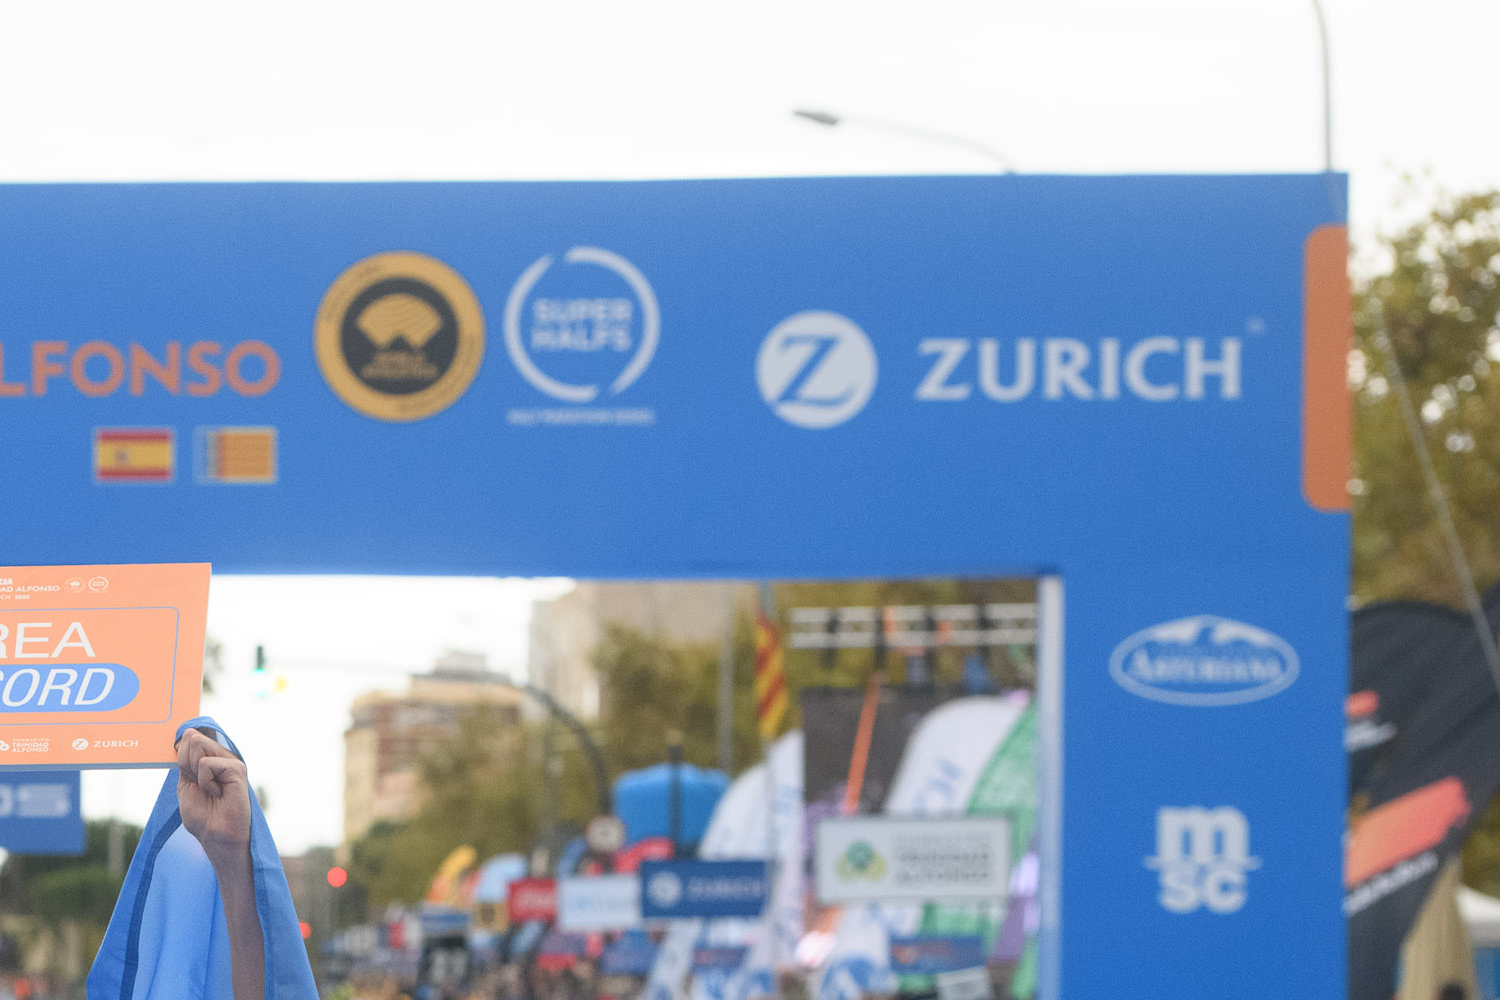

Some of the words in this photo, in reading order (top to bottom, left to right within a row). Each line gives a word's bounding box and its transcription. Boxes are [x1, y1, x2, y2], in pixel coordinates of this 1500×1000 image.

[532, 298, 634, 323] SUPER
[915, 336, 1243, 402] ZURICH
[15, 585, 60, 593] ALFONSO
[93, 740, 139, 748] ZURICH
